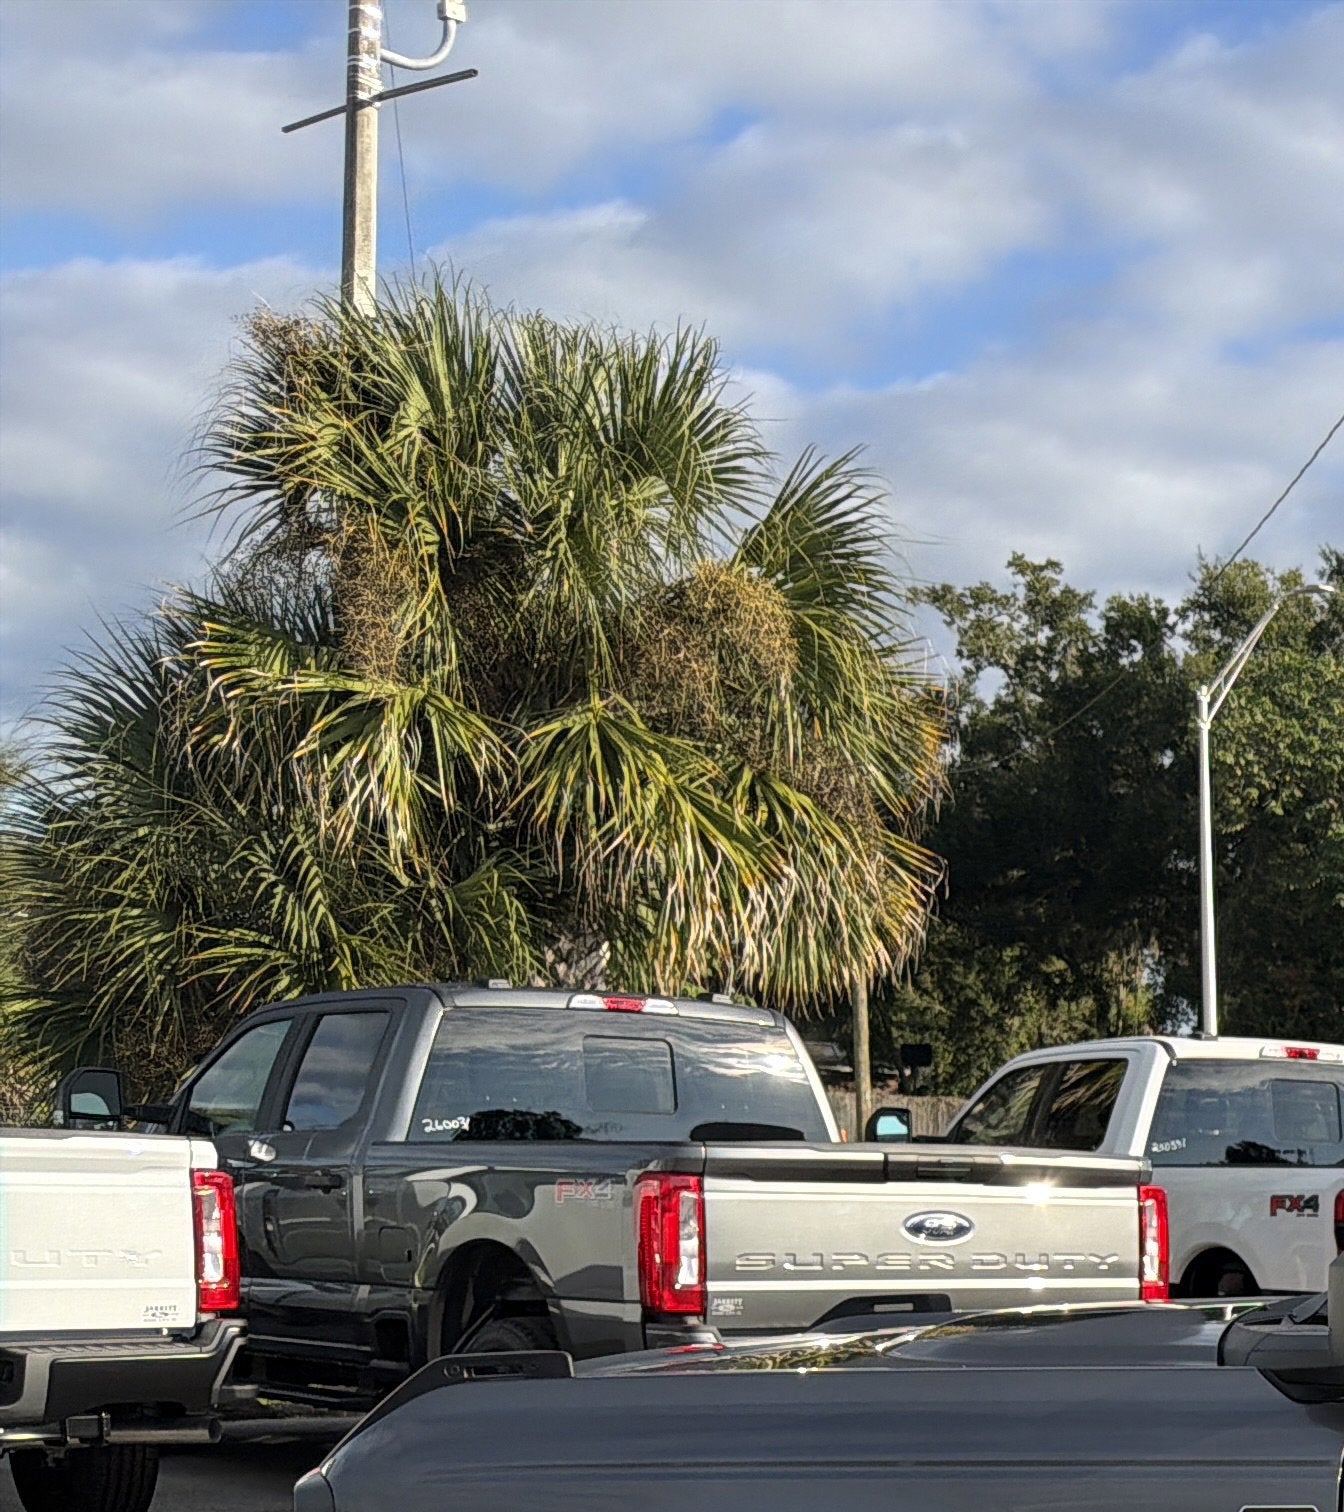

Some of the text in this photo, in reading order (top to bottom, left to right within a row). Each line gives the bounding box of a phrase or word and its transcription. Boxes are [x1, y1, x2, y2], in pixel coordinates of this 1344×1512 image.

[554, 1178, 614, 1204] FX4
[1270, 1194, 1319, 1217] FX4
[735, 1251, 1121, 1272] SUPER DUTY
